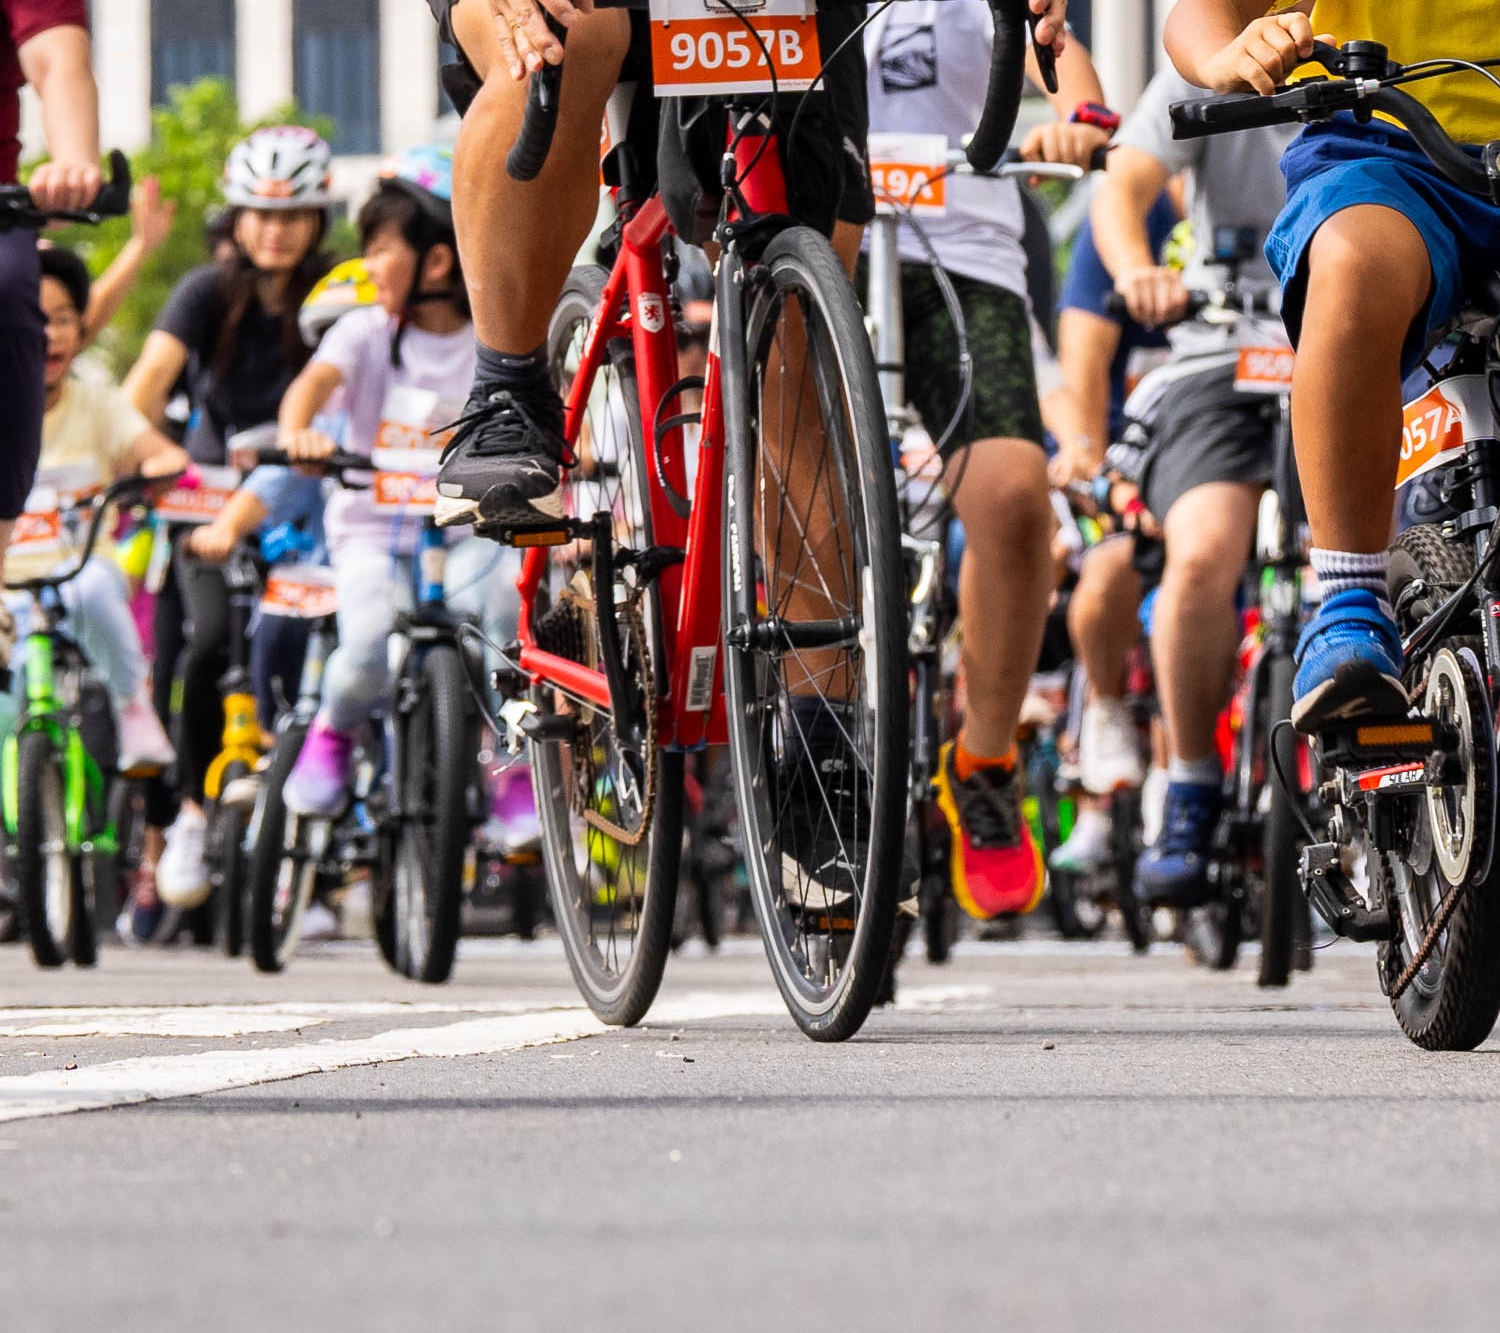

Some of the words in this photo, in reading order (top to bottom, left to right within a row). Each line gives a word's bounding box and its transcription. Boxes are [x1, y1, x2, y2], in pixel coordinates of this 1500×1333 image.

[671, 29, 804, 71] 9057B
[872, 169, 934, 200] 19A
[1400, 405, 1461, 461] 057A
